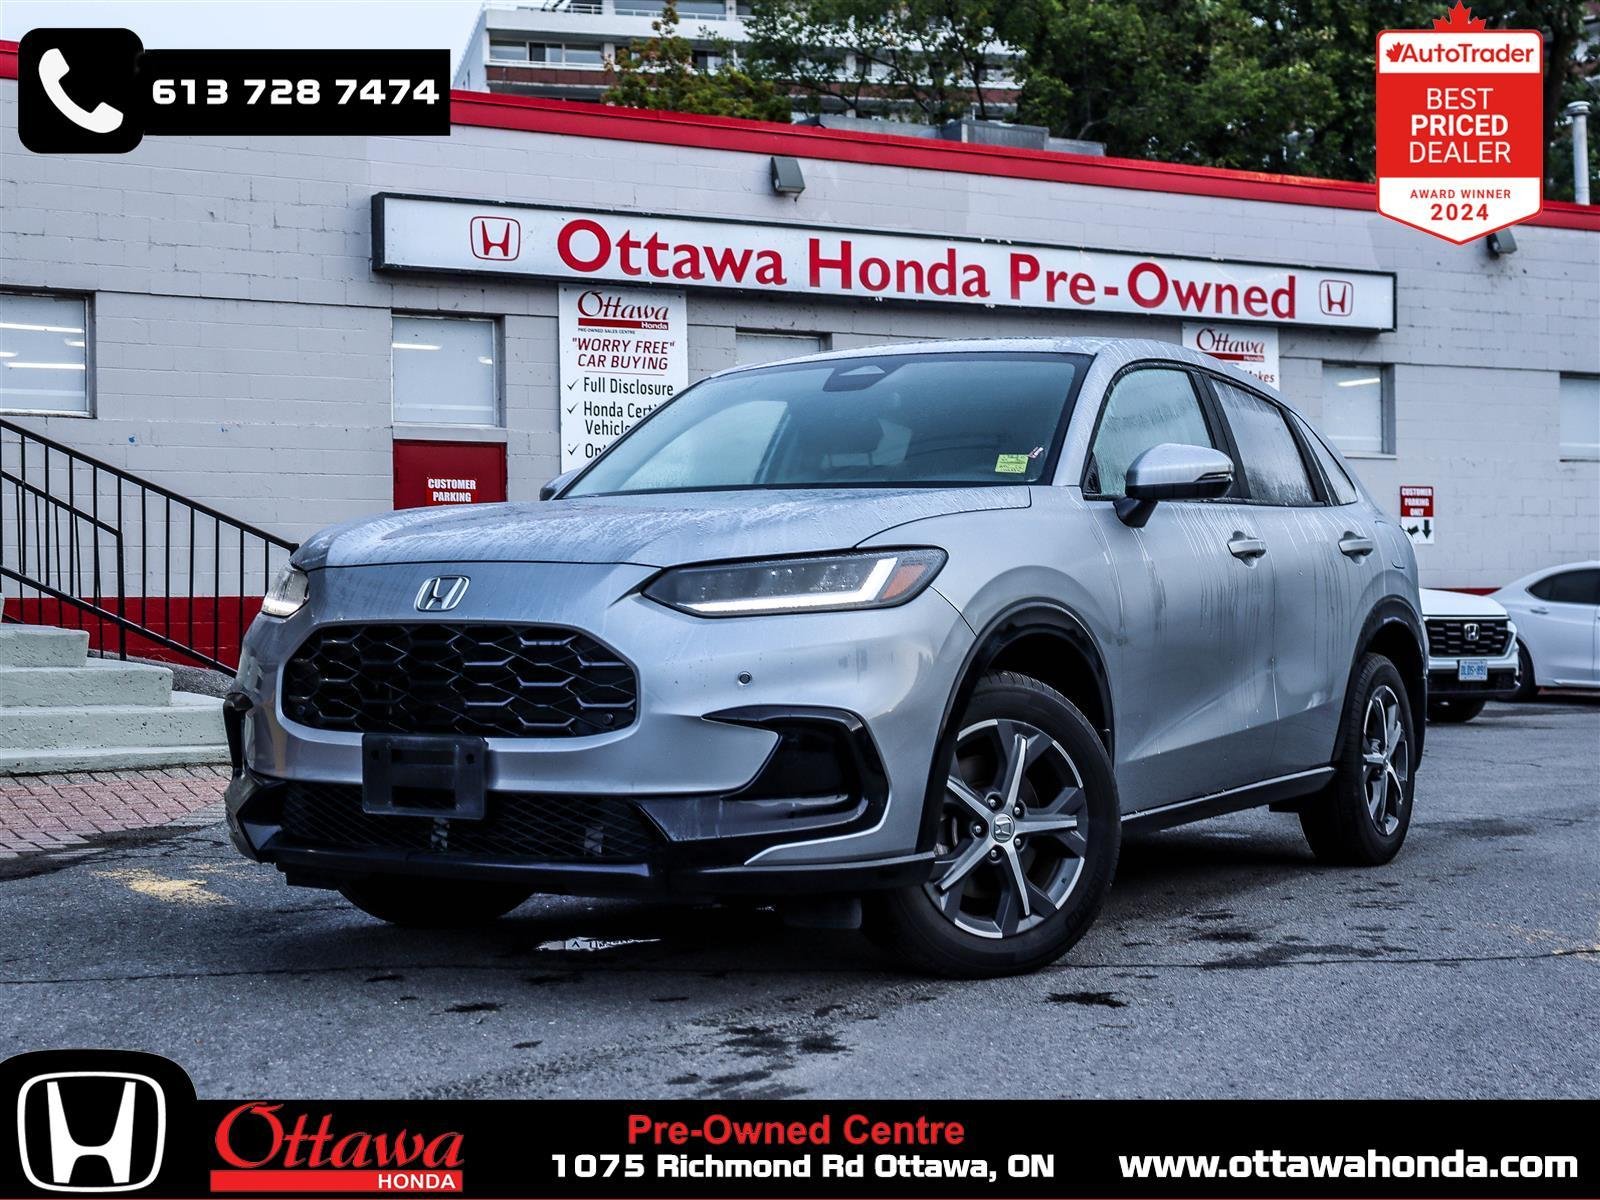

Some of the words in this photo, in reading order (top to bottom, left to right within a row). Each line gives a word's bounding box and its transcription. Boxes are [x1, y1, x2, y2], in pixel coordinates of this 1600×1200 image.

[557, 218, 787, 286] Ottawa
[808, 238, 990, 297] Honda
[1010, 252, 1297, 319] Pre-Owned
[577, 290, 669, 321] Ottawa
[641, 321, 668, 330] Honda
[572, 337, 631, 353] "WORRY
[1196, 327, 1265, 354] Ottawa
[577, 353, 606, 368] CAR
[610, 356, 668, 370] BUYING
[583, 377, 606, 393] Full
[610, 379, 674, 396] Disclosure
[583, 400, 623, 417] Honda
[627, 402, 657, 418] Cert
[427, 478, 477, 490] CUSTOMER
[1401, 487, 1432, 496] CUSTOMER
[432, 491, 472, 503] PARKING
[1404, 497, 1430, 507] PARKING
[1410, 508, 1424, 516] ONLY
